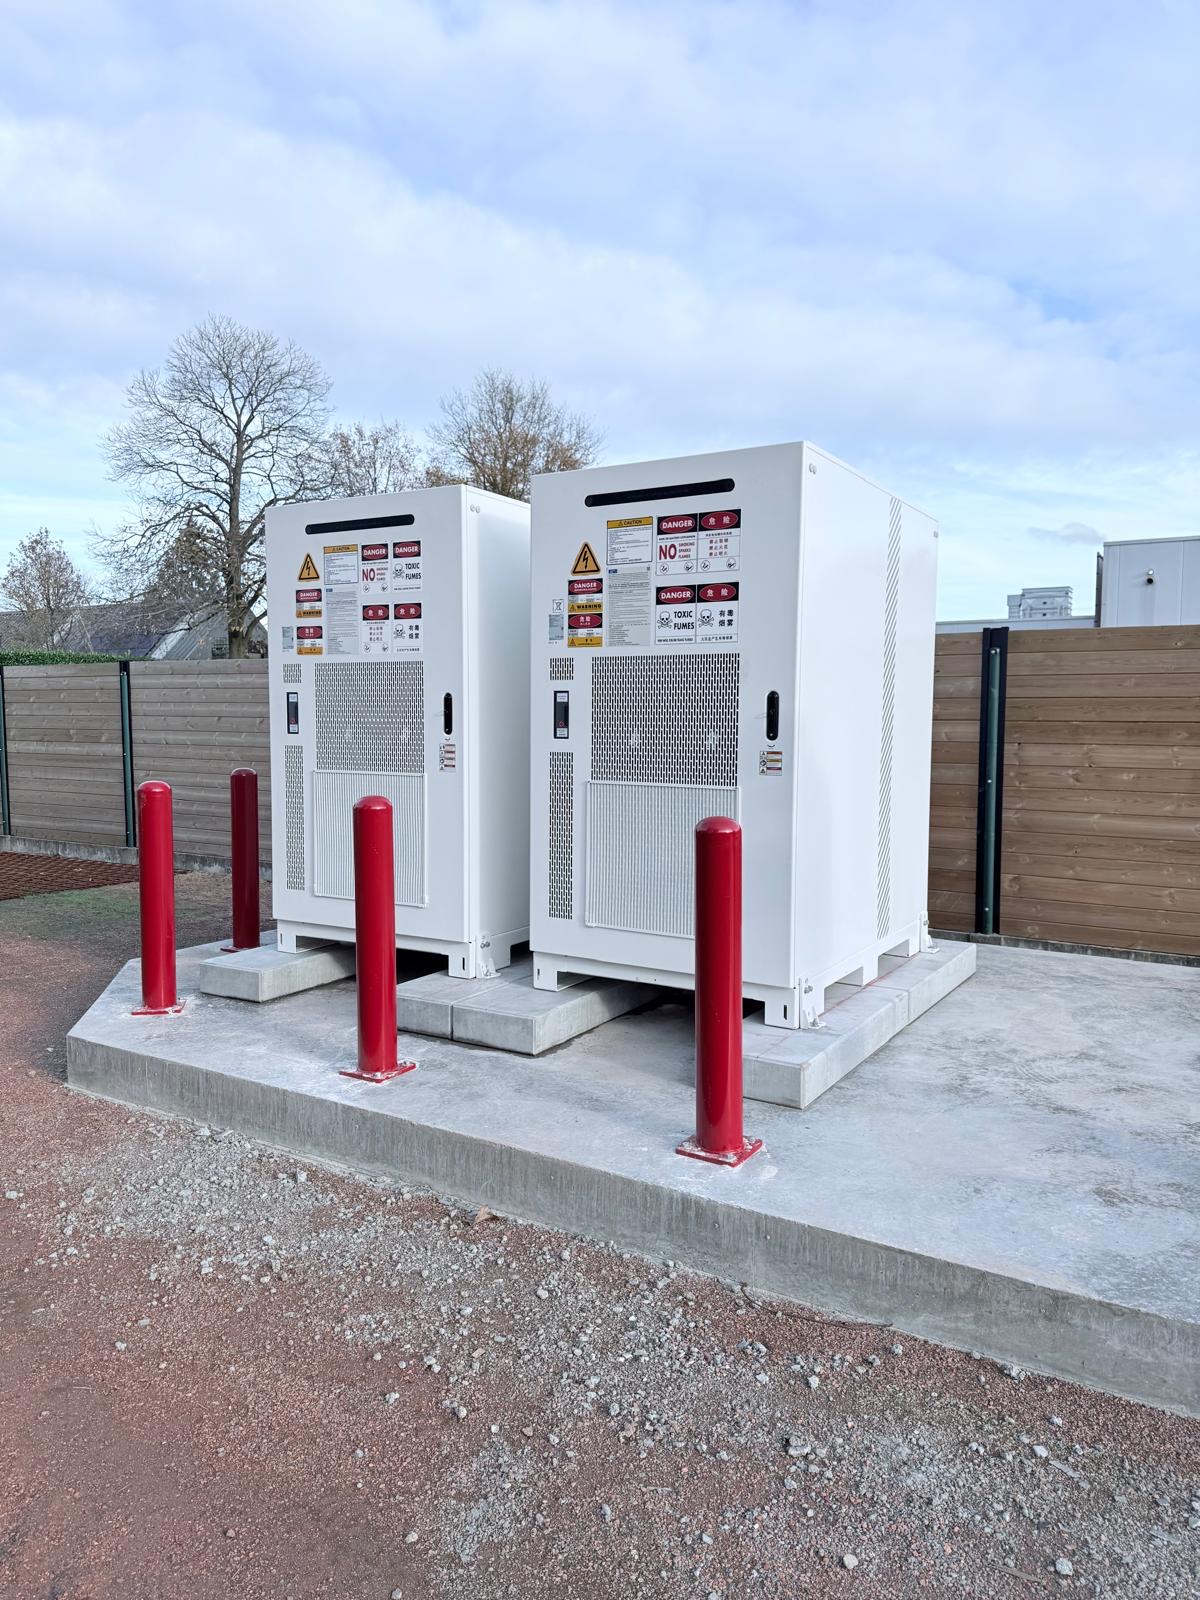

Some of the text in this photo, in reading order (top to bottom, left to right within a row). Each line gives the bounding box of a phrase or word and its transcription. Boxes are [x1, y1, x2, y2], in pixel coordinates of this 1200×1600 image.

[662, 519, 693, 529] DANGER
[363, 548, 386, 556] DANGER
[659, 543, 677, 560] NO
[405, 562, 420, 570] TOXIC
[362, 567, 376, 581] NO
[405, 572, 421, 580] FUMES
[661, 591, 691, 599] DANGER
[673, 610, 693, 618] TOXIC
[673, 621, 695, 630] FUMES
